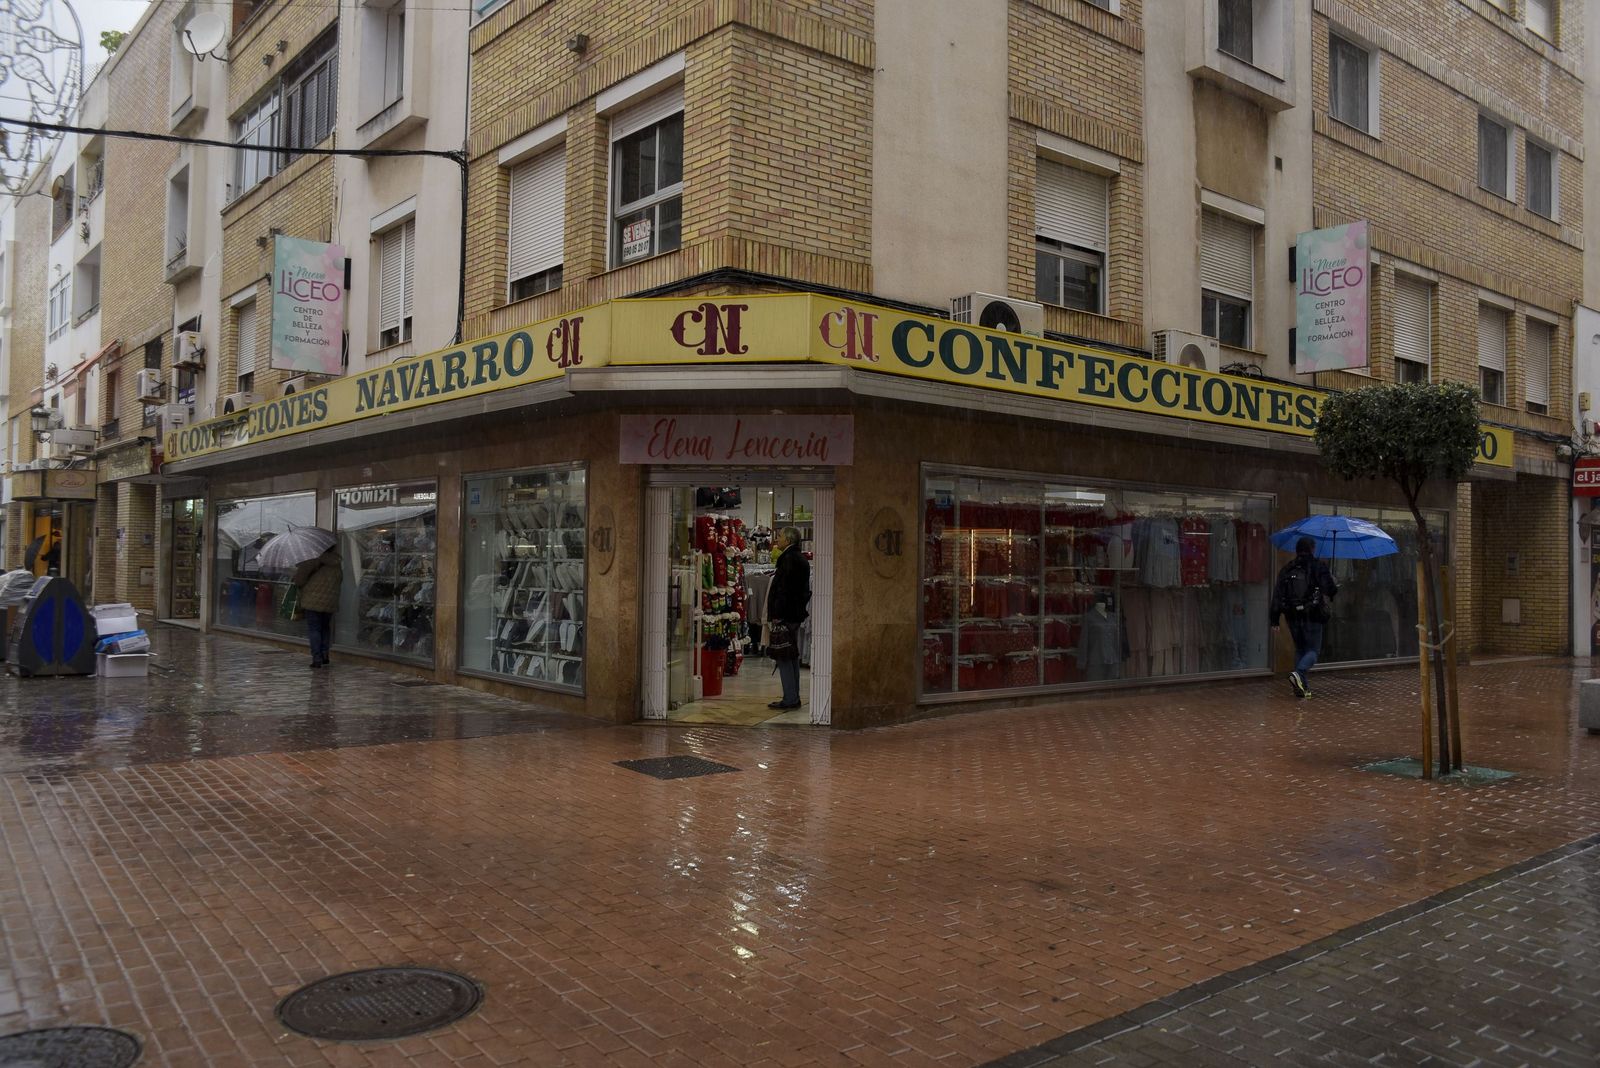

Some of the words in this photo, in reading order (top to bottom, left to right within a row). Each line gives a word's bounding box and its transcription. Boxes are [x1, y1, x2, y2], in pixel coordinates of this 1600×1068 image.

[1313, 258, 1347, 271] Nuevo
[292, 265, 326, 279] Nuevo
[293, 306, 324, 316] CENTRO
[1315, 299, 1346, 310] CENTRO
[292, 321, 323, 330] BELLEZA
[1315, 315, 1346, 326] BELLEZA
[670, 303, 749, 355] CN
[1307, 329, 1354, 342] FORMACIÓN
[891, 319, 1319, 430] CONFECCIONES
[180, 388, 328, 455] CONCCIONES
[355, 331, 534, 413] NAVARRO
[647, 418, 714, 461] Elena
[1577, 471, 1588, 482] el
